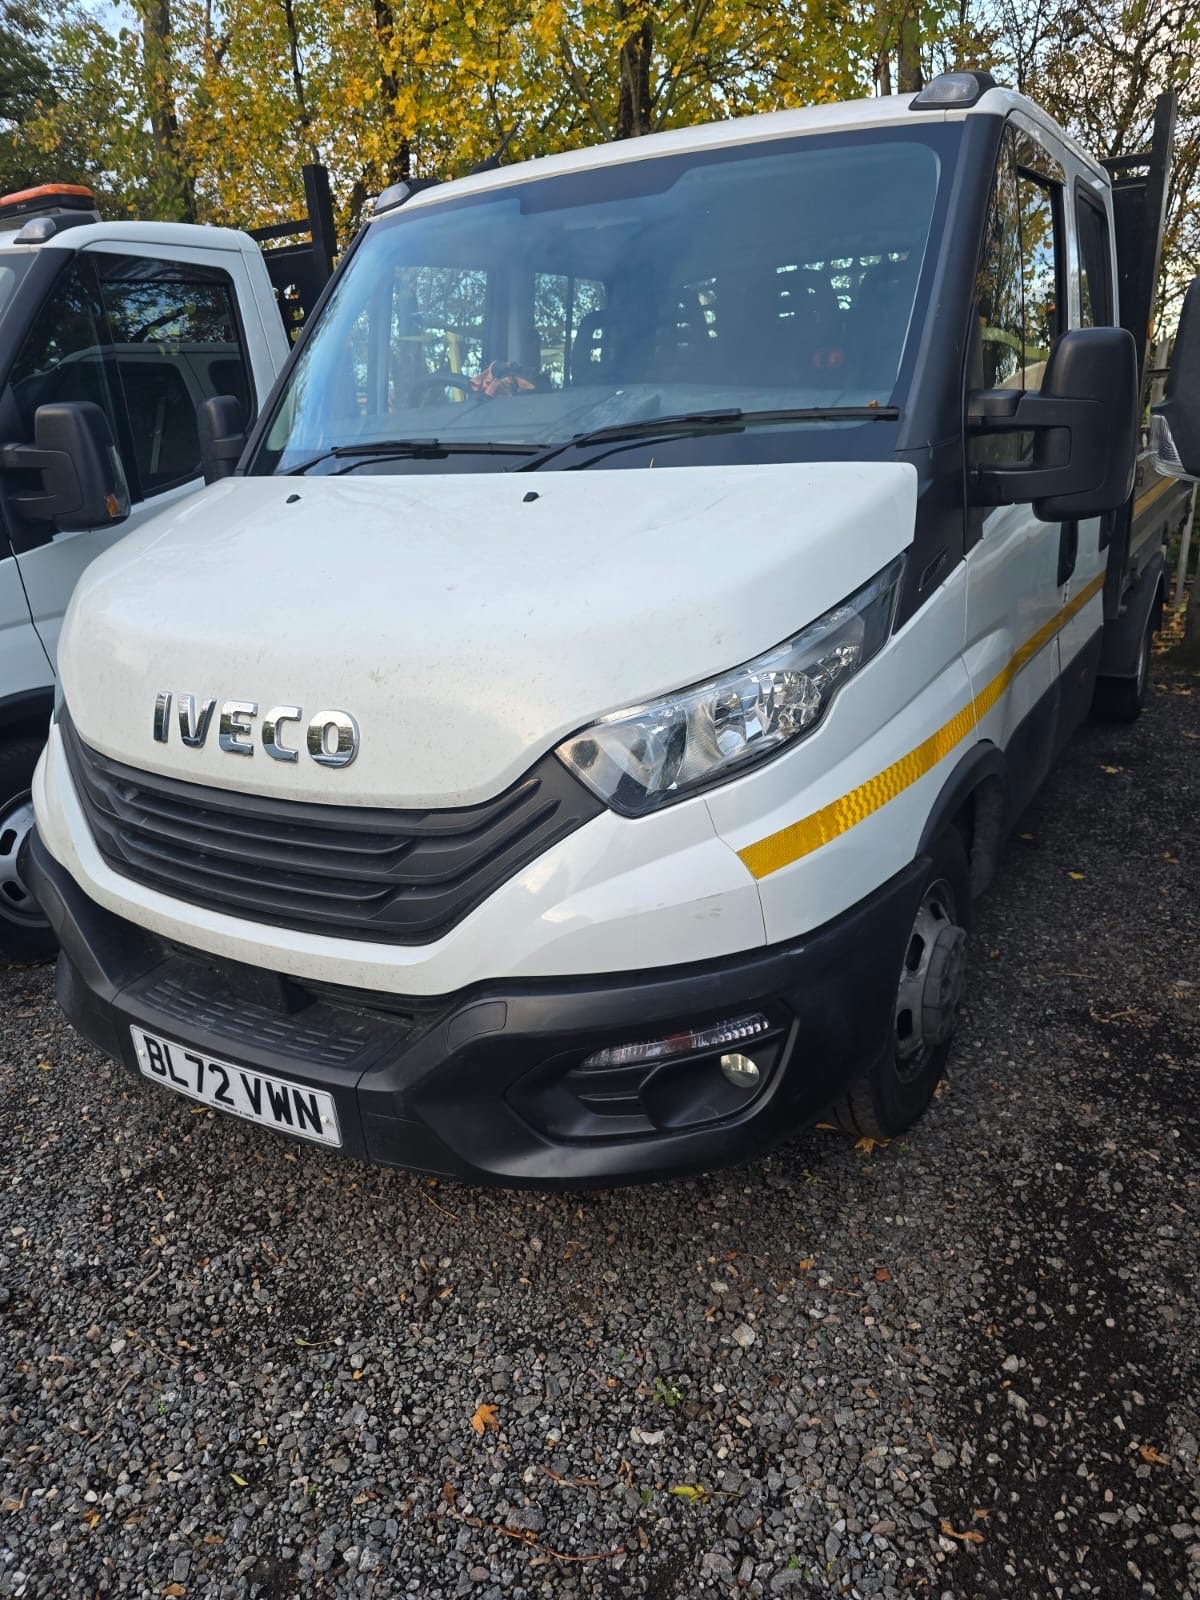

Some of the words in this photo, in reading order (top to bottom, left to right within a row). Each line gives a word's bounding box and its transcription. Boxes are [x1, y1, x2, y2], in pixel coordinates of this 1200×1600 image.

[153, 690, 360, 769] IVECO
[143, 1035, 235, 1106] BL72
[240, 1073, 323, 1134] VWN
